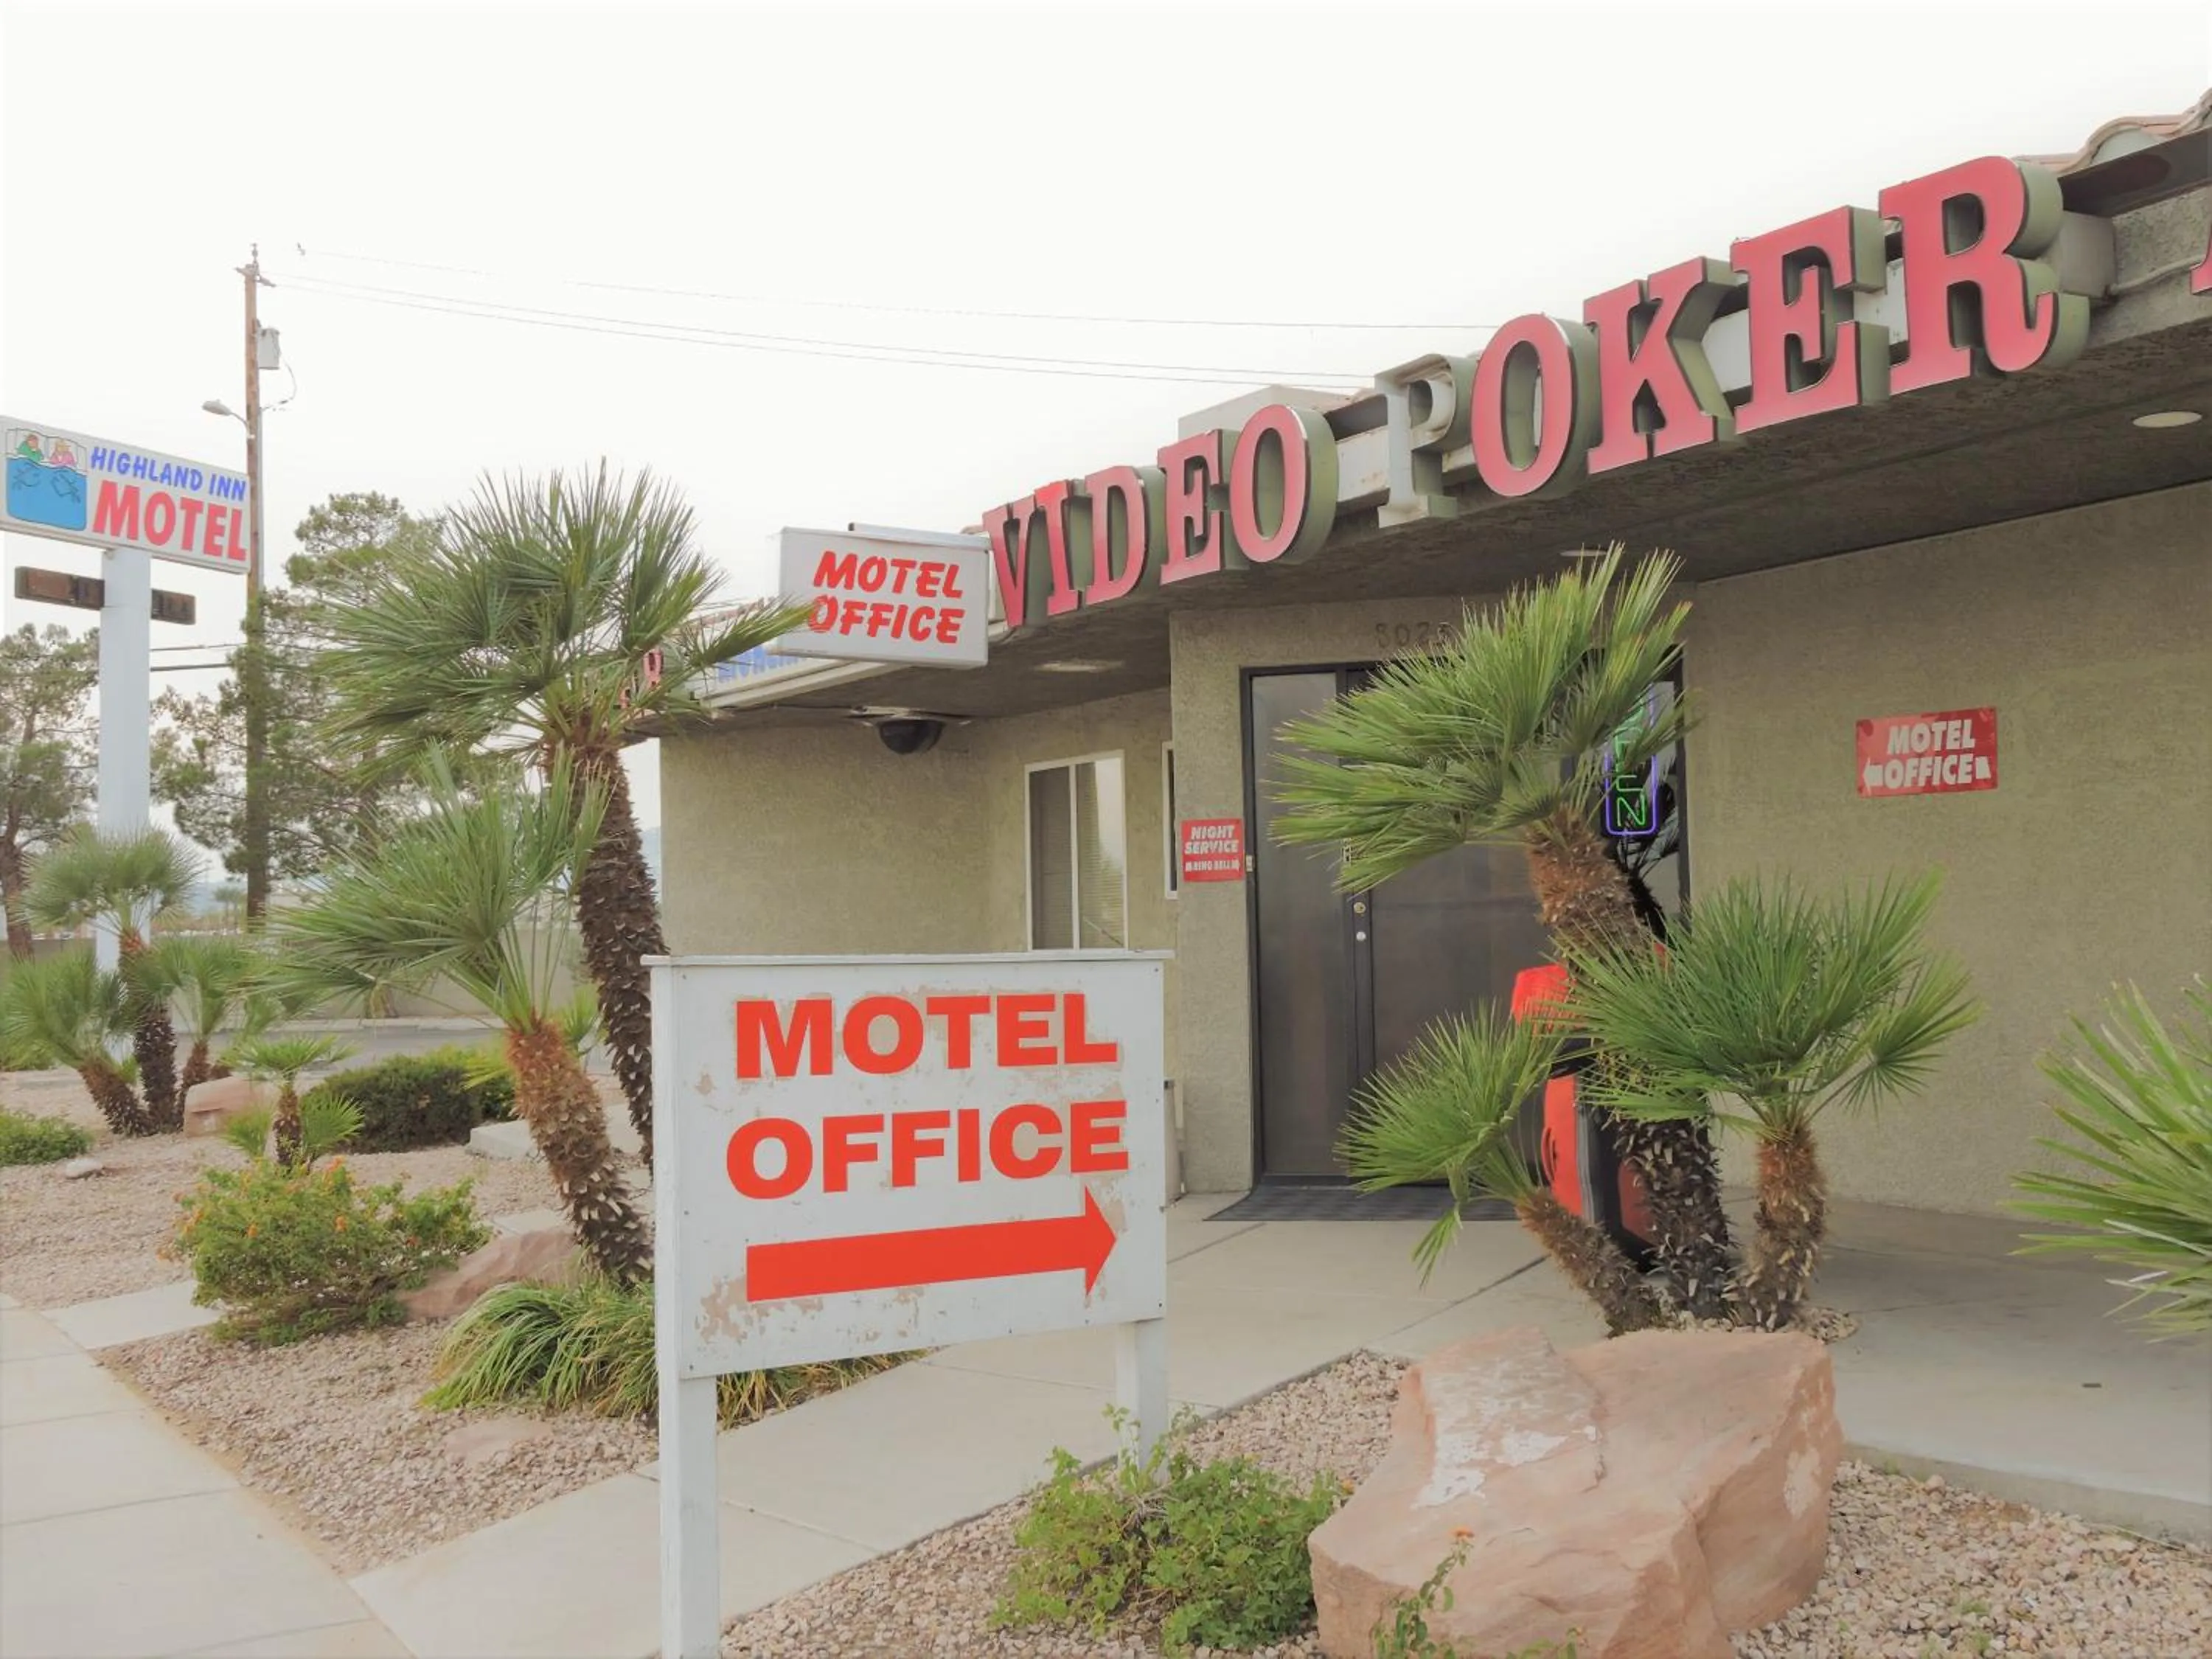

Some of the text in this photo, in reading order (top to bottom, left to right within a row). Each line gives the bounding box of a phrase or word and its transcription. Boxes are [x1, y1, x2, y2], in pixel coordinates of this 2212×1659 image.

[982, 156, 2068, 627] VIDEO POKER
[91, 447, 246, 501] HIGHLAND INN
[92, 479, 248, 562] MOTEL
[813, 550, 964, 599] MOTEL
[807, 595, 966, 644] OFFICE
[1886, 719, 1976, 755] MOTEL
[1885, 753, 1974, 789] OFFICE
[1184, 840, 1239, 855] SERVICE
[1191, 825, 1234, 839] NIGHT
[736, 993, 1118, 1079] MOTEL
[726, 1100, 1129, 1200] OFFICE
